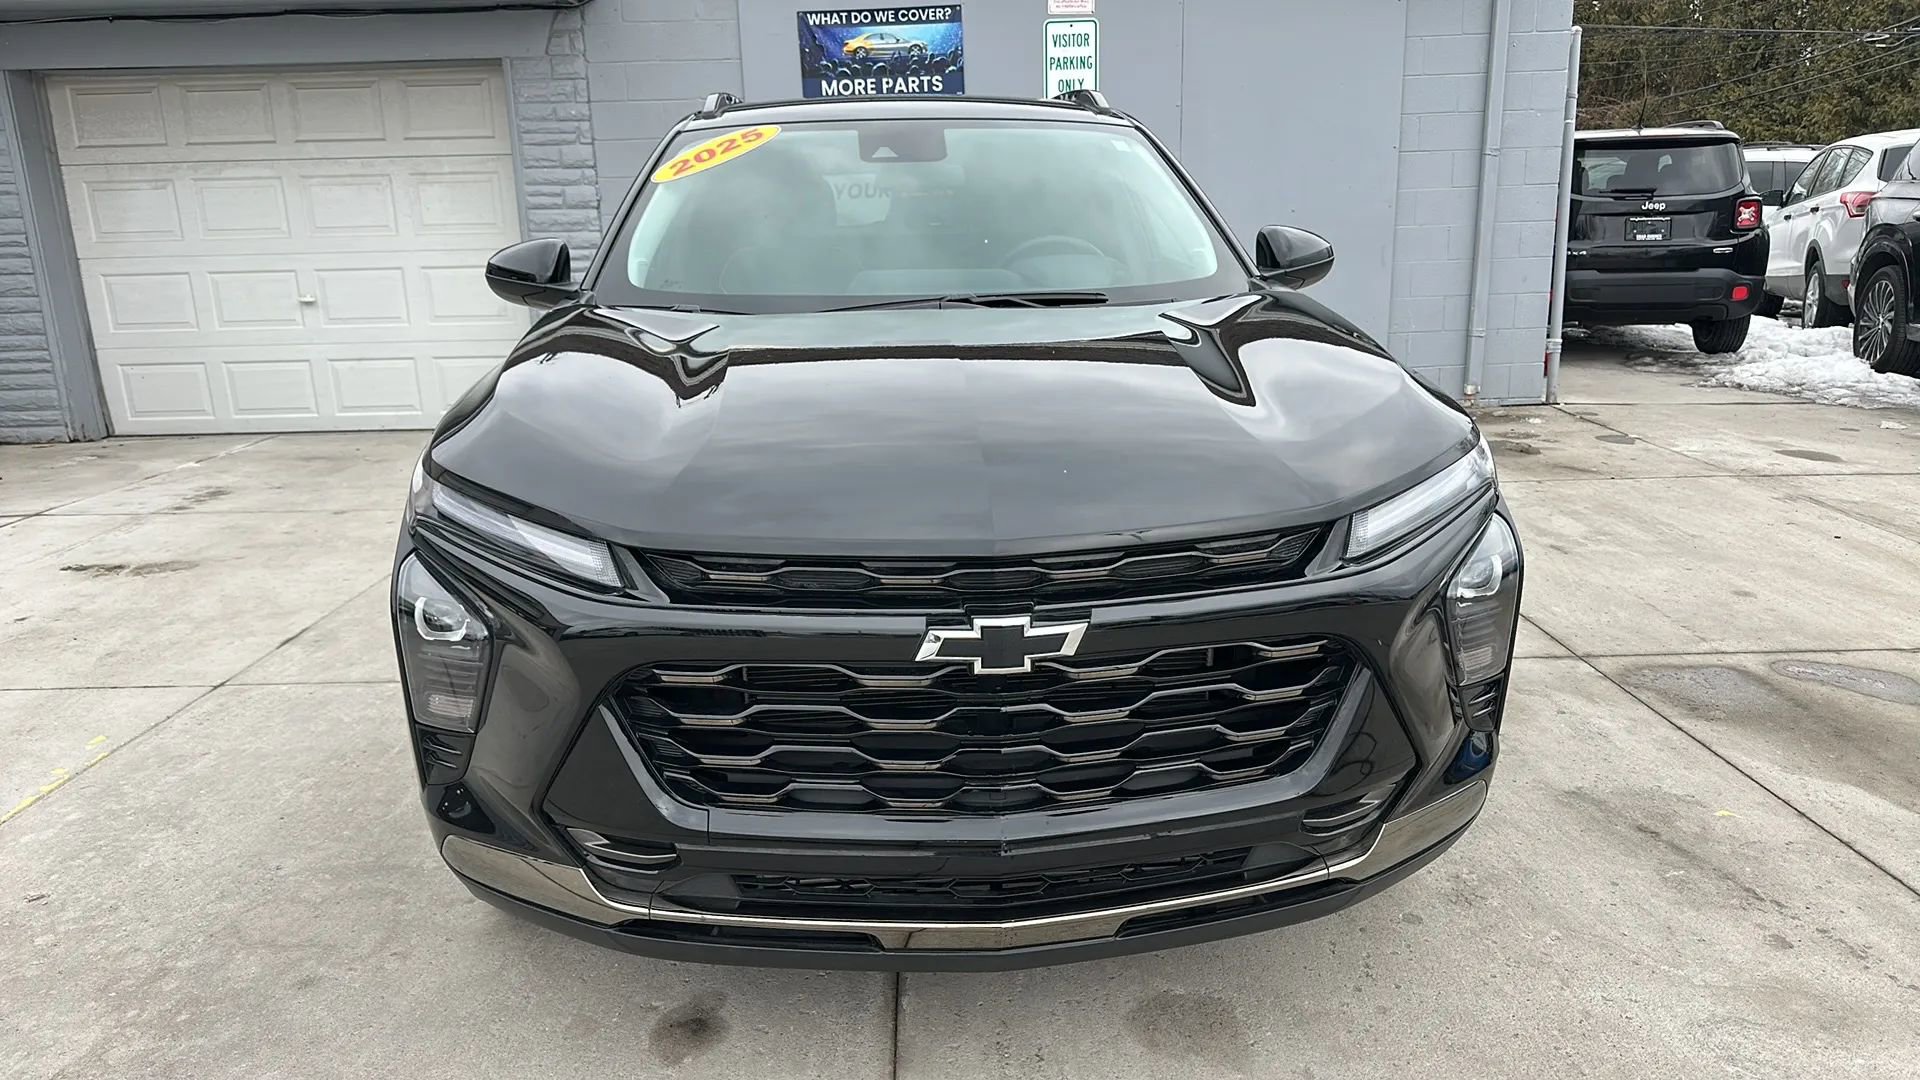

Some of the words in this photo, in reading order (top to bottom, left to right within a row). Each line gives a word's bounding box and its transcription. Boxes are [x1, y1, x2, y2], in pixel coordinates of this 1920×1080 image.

[807, 12, 848, 26] WHAT
[851, 11, 872, 24] DO
[874, 10, 895, 23] WE
[898, 7, 952, 22] COVER?
[1052, 33, 1090, 48] VISITOR
[1049, 55, 1093, 71] PARKING
[821, 78, 877, 96] MORE
[882, 75, 944, 94] PARTS
[669, 128, 764, 177] 2025
[1641, 201, 1666, 211] Jeep
